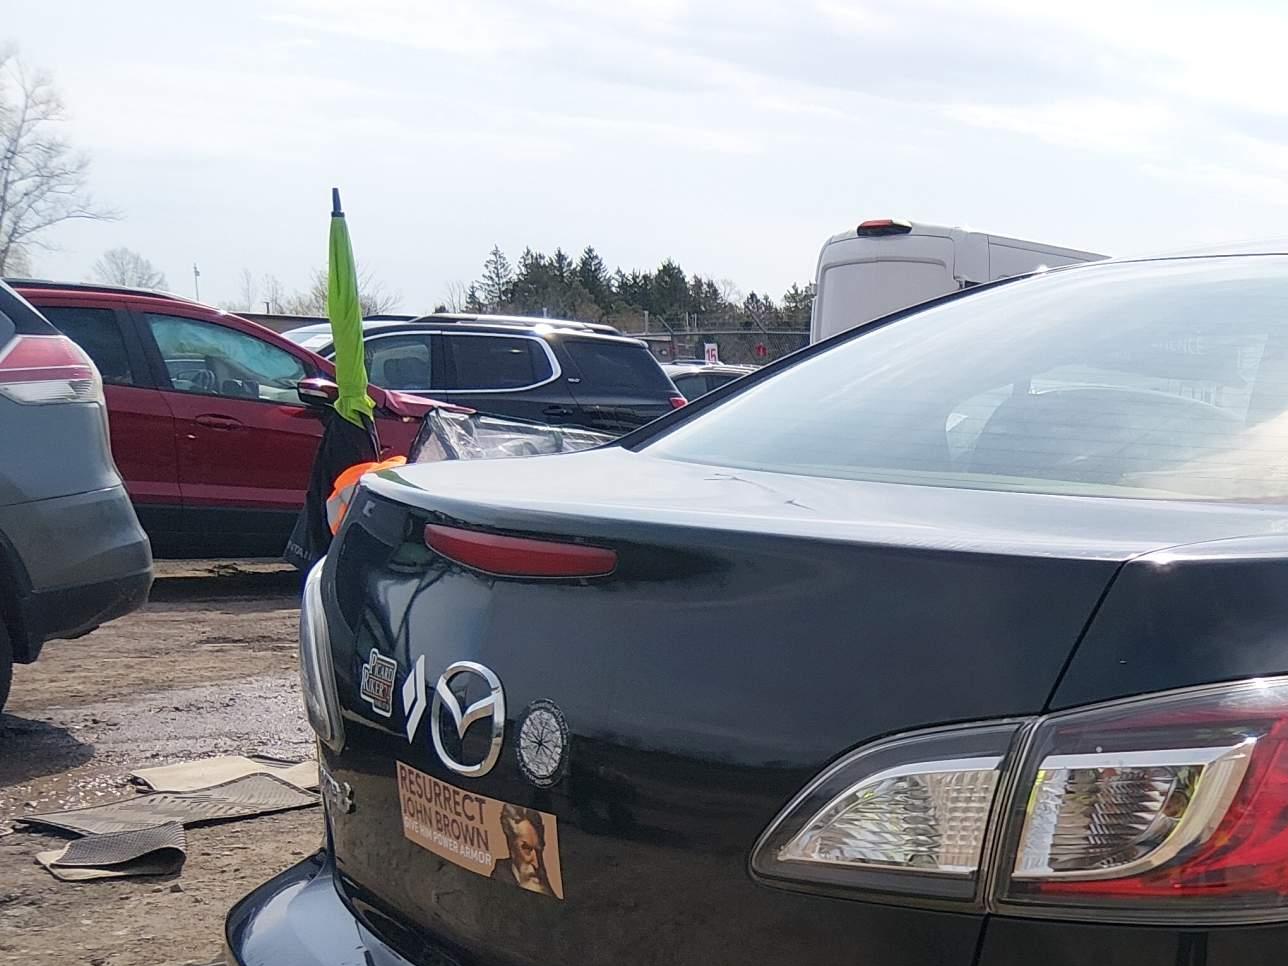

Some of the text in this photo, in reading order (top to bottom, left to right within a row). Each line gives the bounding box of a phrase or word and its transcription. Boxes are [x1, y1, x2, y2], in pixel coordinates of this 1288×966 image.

[369, 653, 394, 684] PICARD
[399, 764, 486, 825] RESURRECT
[402, 793, 489, 851] JOHN BROWN
[433, 830, 459, 853] POWER
[459, 843, 492, 867] ARMOR
